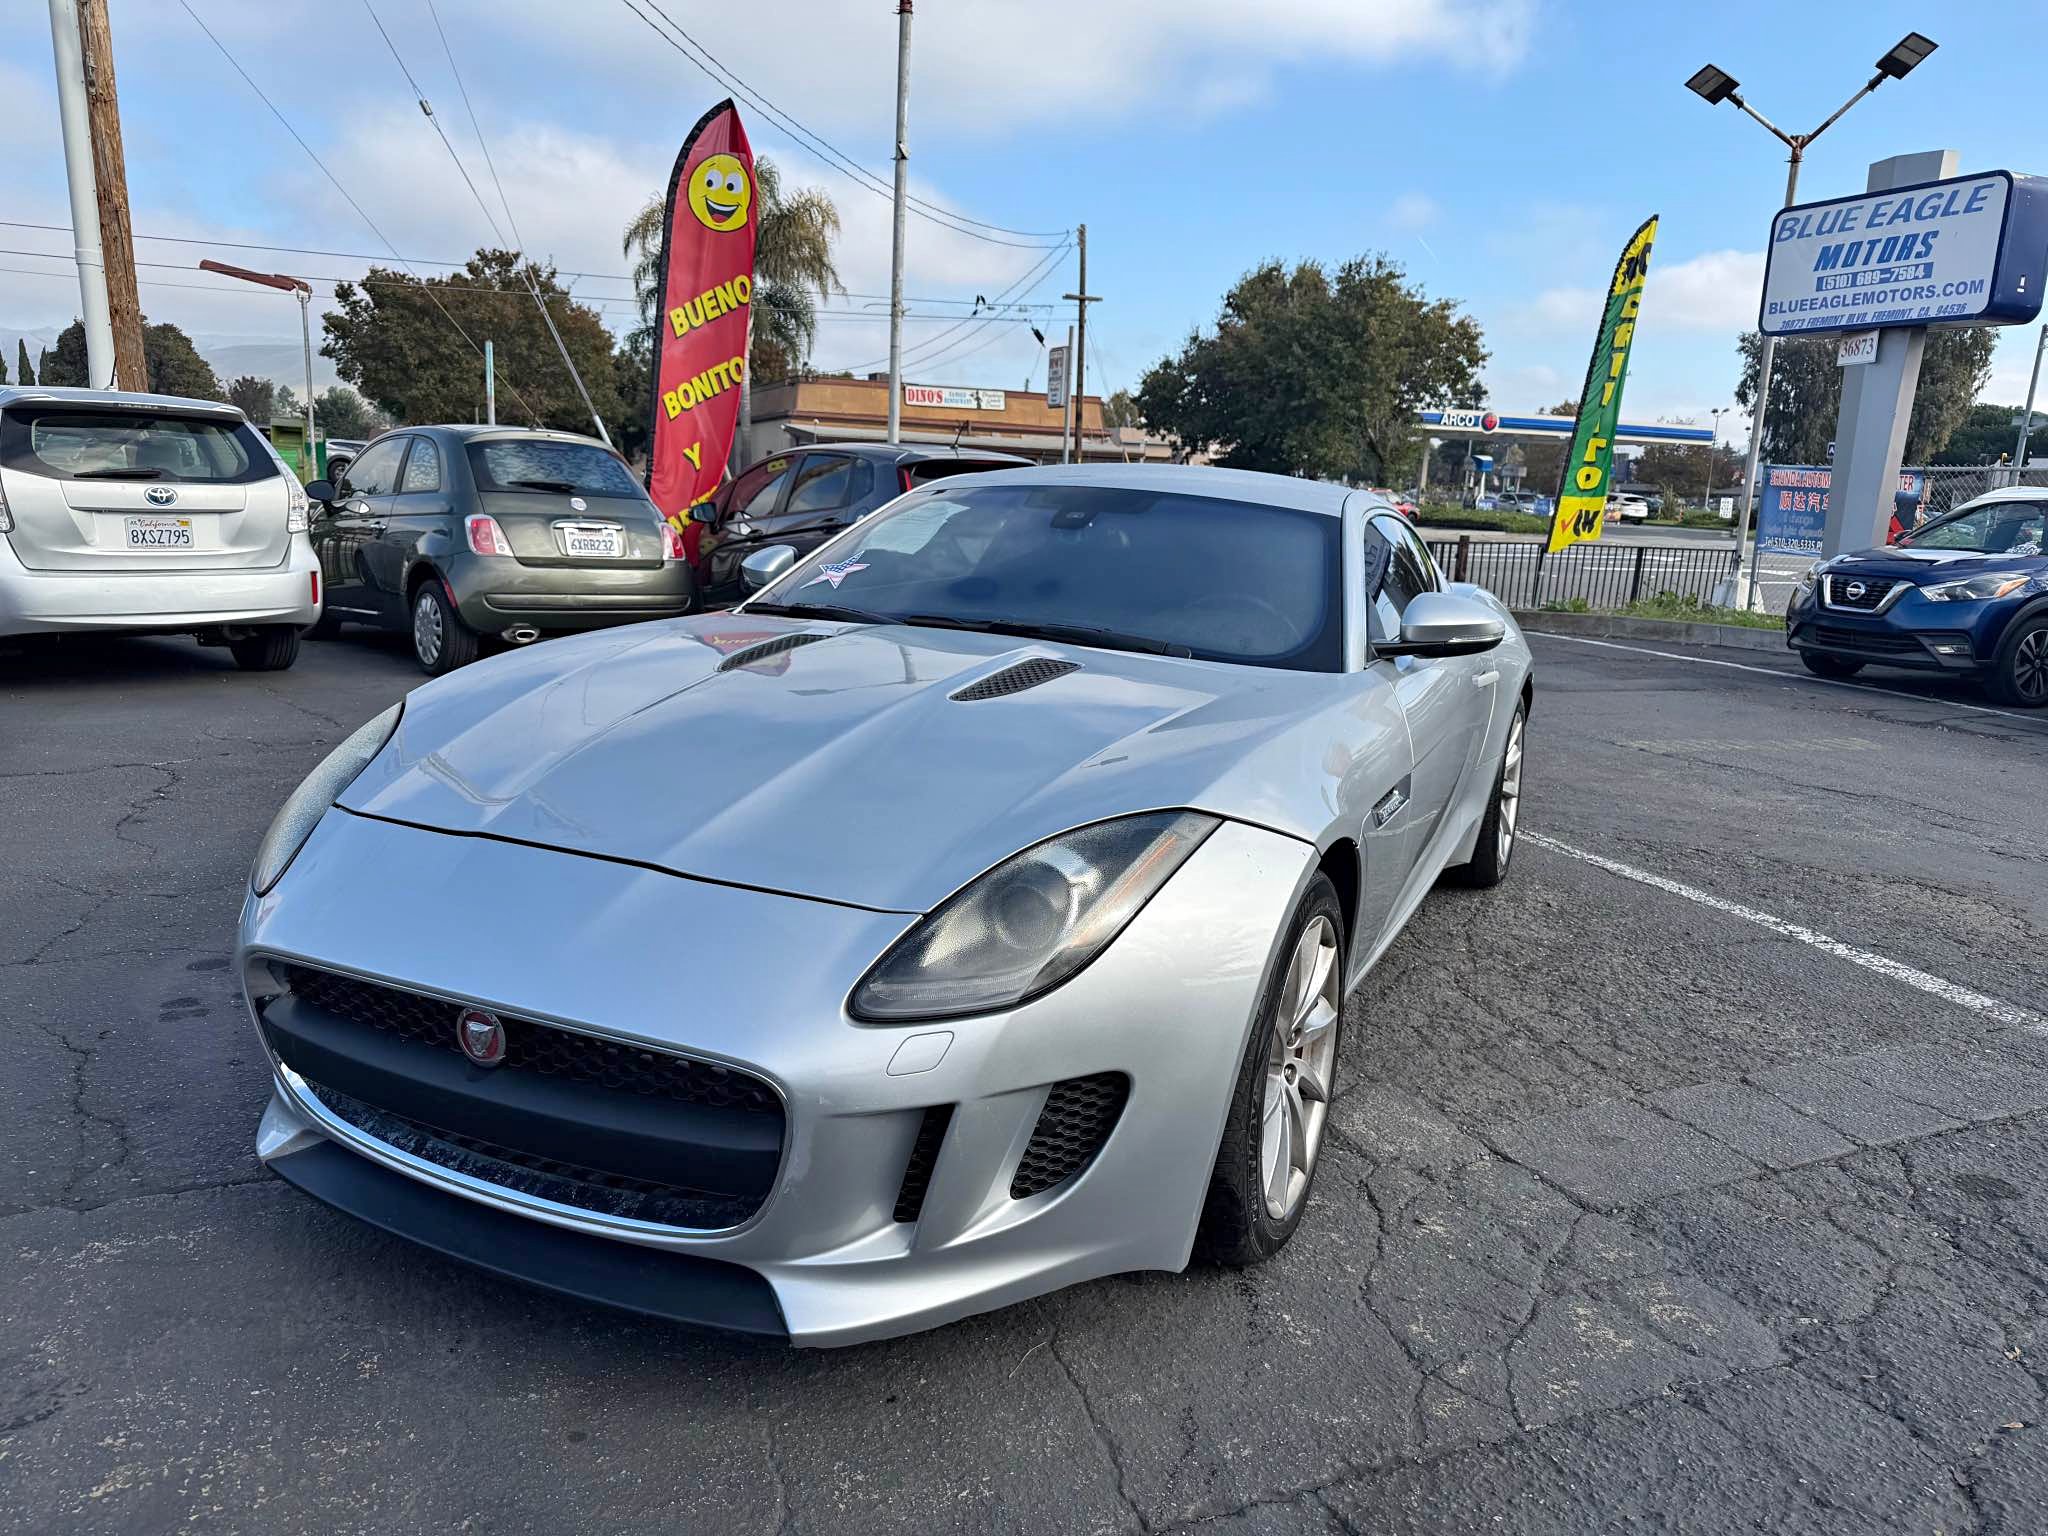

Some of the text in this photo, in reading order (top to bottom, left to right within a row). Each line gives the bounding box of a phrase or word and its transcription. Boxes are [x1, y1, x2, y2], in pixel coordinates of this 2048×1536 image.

[1775, 183, 1995, 243] BLUE EAGLE
[1813, 230, 1940, 272] MOTORS
[1822, 274, 1852, 290] (510)
[669, 274, 751, 338] BUENO
[1768, 279, 1985, 315] BLUEEAGLEMOTORS.COM
[1807, 314, 1846, 328] FREMONT
[1841, 338, 1874, 358] 36873
[663, 356, 744, 420] BONITO
[907, 388, 944, 404] DINO'S
[1440, 413, 1475, 426] ARCO
[683, 442, 701, 471] Y
[1802, 471, 1831, 489] AUTOM
[131, 529, 190, 544] 8XSZ795
[571, 538, 615, 551] 6XRB232
